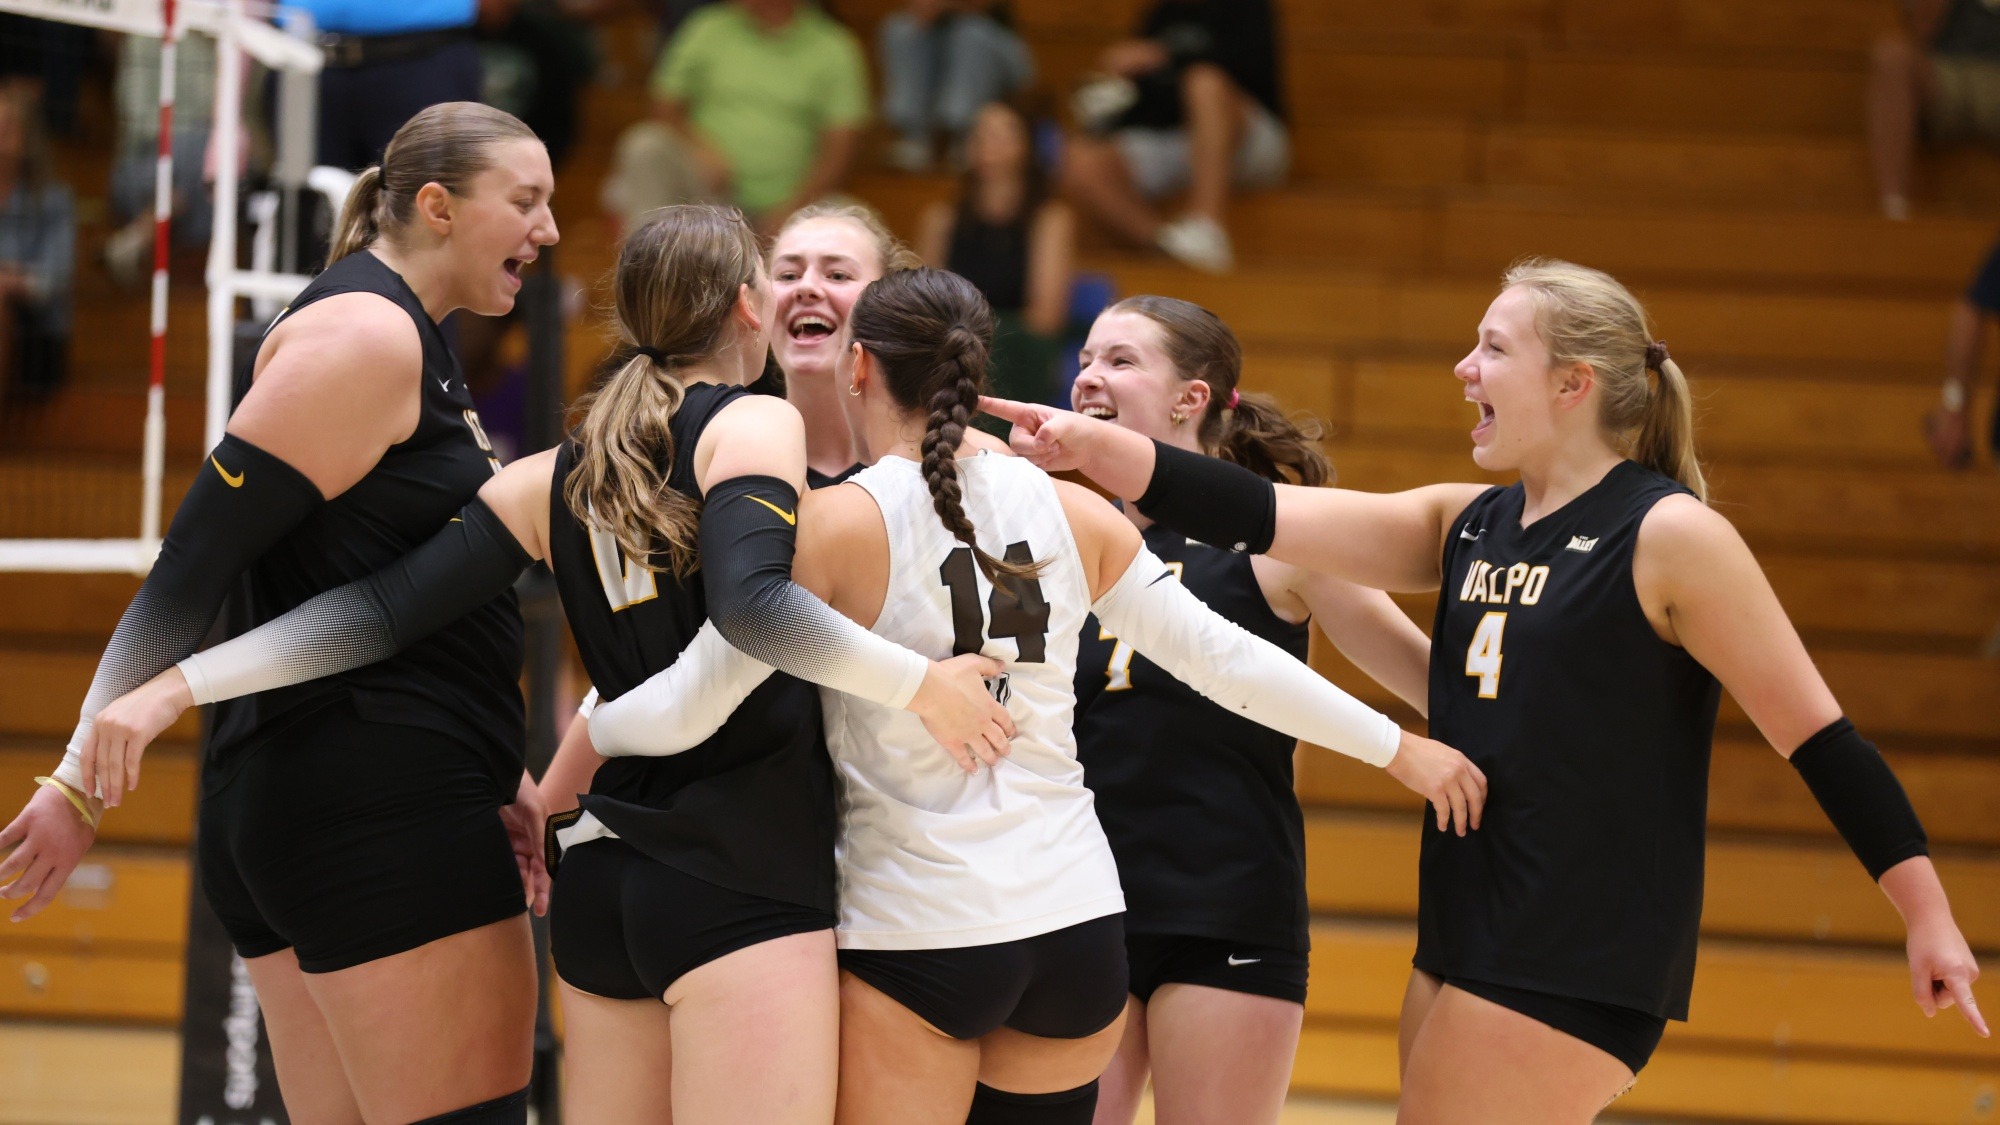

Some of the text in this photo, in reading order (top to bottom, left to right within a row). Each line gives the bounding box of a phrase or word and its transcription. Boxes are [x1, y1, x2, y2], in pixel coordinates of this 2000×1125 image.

[939, 540, 1051, 664] 14
[1459, 560, 1550, 606] VALPO
[1465, 611, 1508, 699] 4
